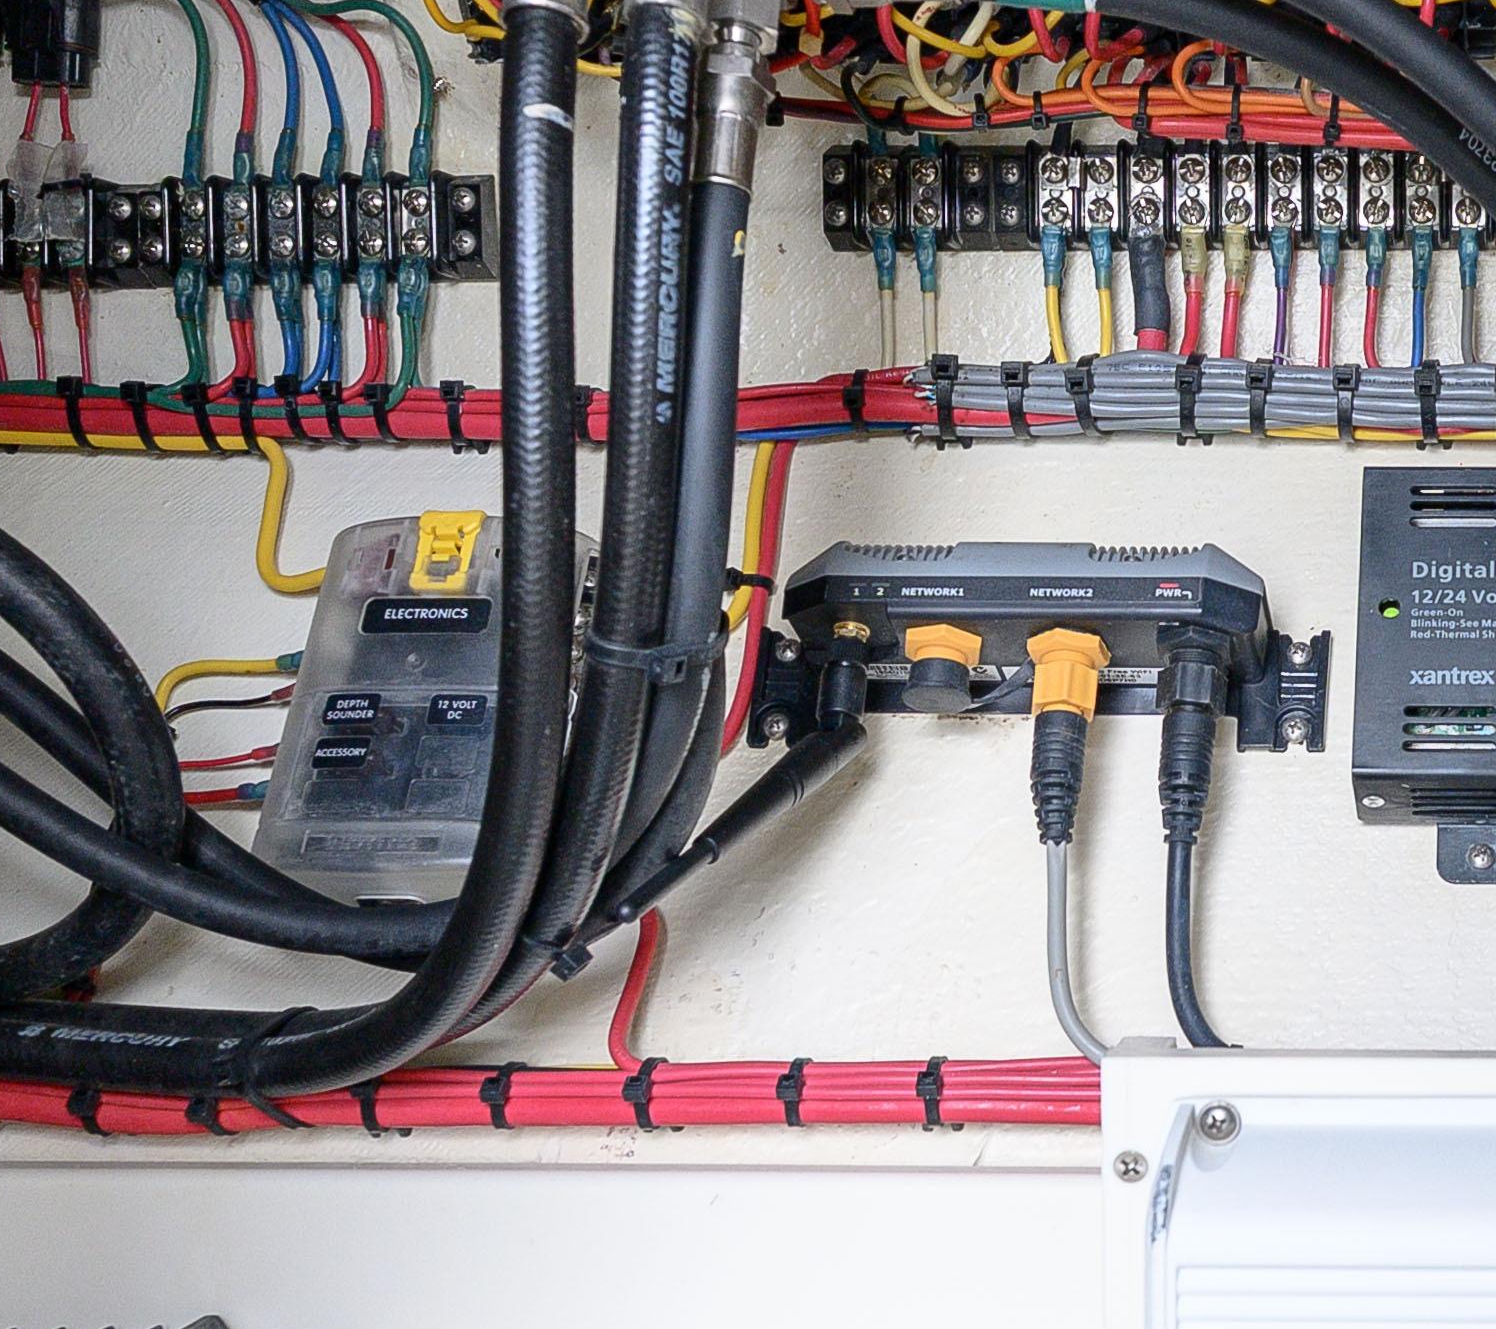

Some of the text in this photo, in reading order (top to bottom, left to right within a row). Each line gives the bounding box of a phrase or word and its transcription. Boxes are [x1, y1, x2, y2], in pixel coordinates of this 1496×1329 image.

[664, 123, 688, 186] SAE
[1412, 560, 1495, 581] Digital
[901, 587, 964, 597] NETWORK1
[1029, 588, 1093, 598] NETWORK2
[1155, 588, 1183, 598] PWR
[1412, 590, 1467, 605] 12/24
[384, 607, 469, 619] ELECTRONICS
[1410, 608, 1464, 617] Green-On
[1410, 618, 1480, 630] Blinking-See
[1410, 629, 1480, 639] Red-Thermal
[1409, 667, 1496, 685] xantrex
[336, 699, 368, 709] DEPTH
[437, 700, 477, 709] 12 VOLT
[326, 709, 375, 720] SOUNDER
[447, 711, 462, 720] DC
[315, 747, 367, 757] ACCESSORY
